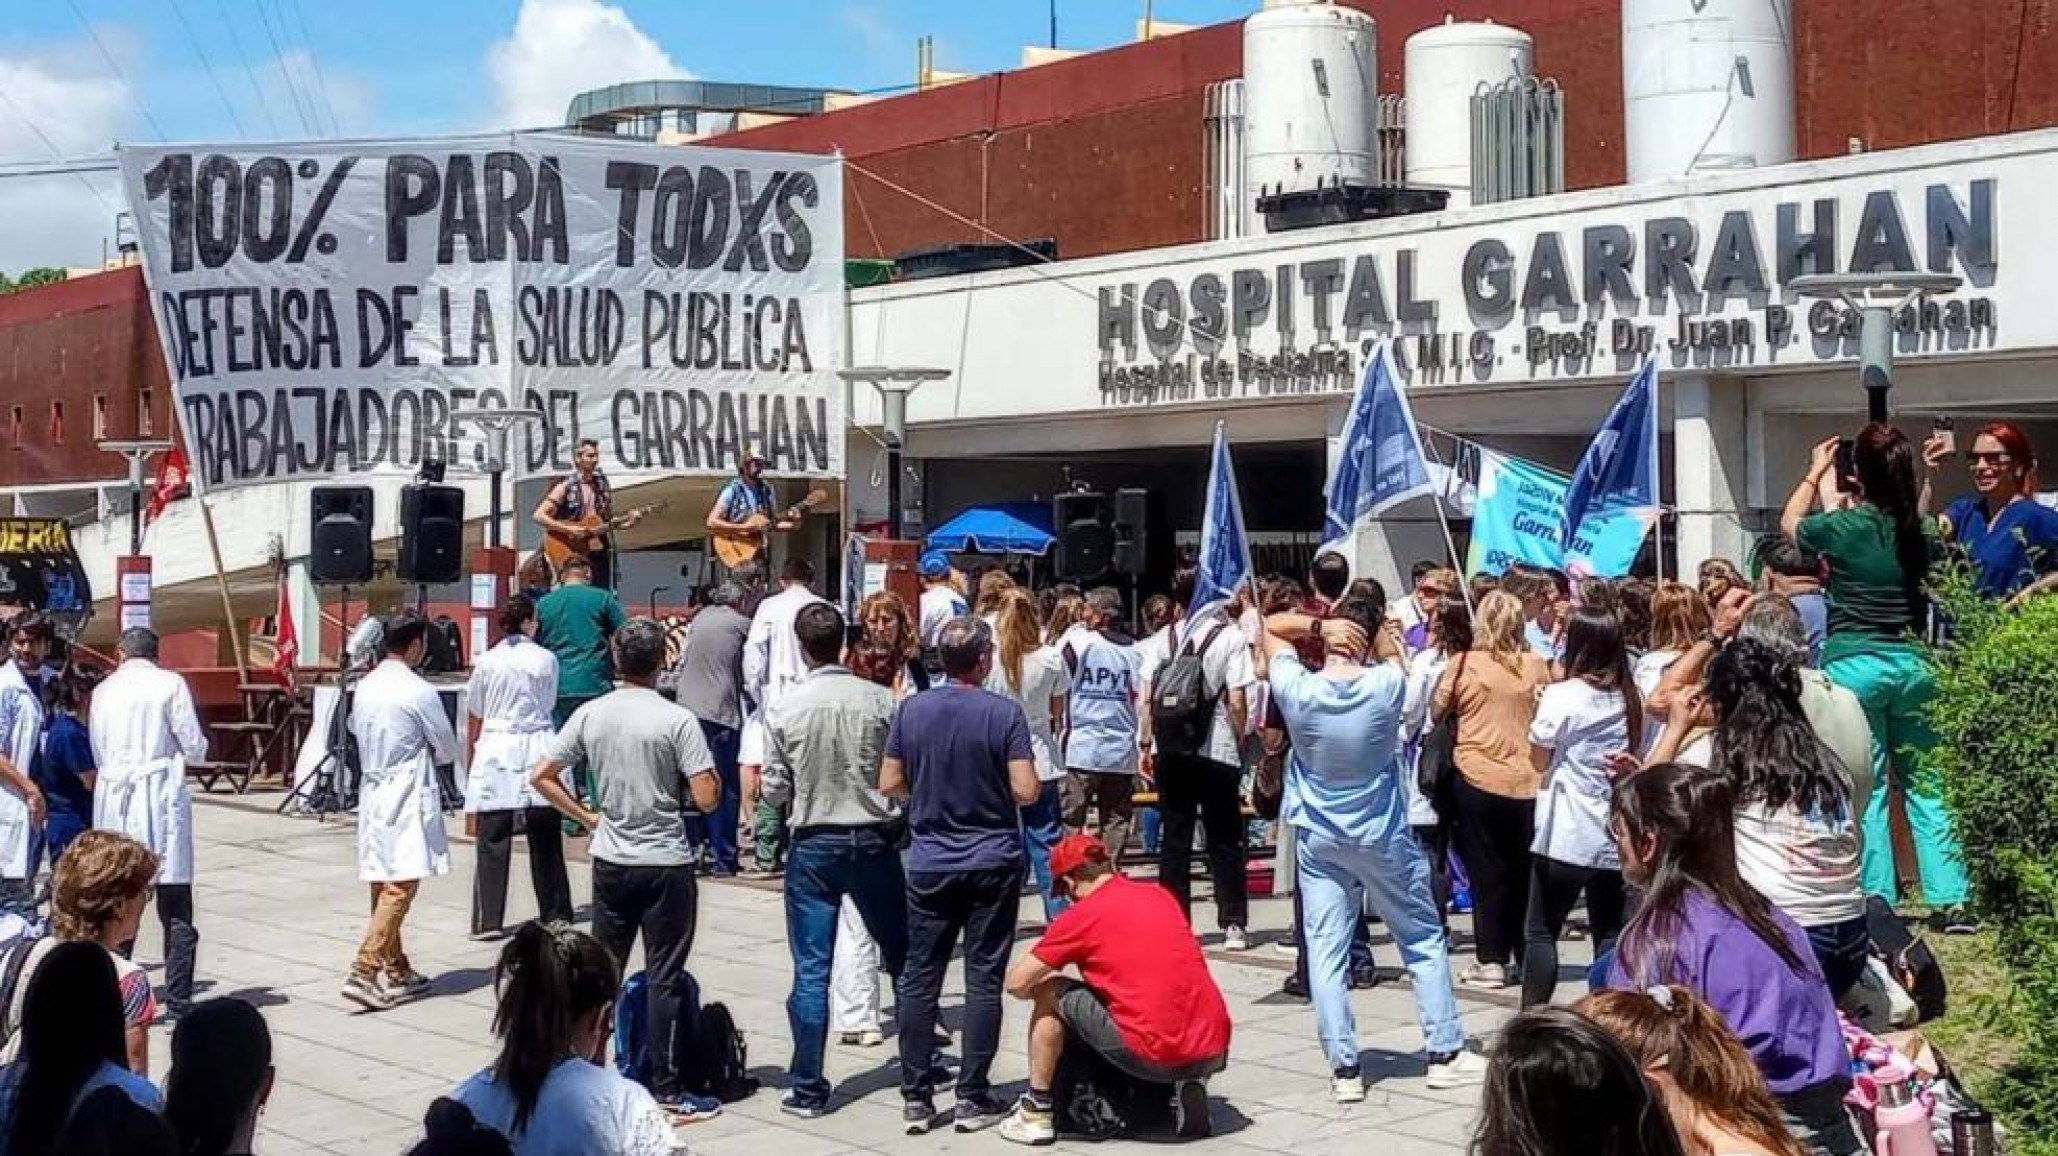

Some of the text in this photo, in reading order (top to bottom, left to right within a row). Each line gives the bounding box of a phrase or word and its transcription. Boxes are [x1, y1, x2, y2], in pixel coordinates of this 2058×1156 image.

[143, 151, 819, 273] 100% PARA TODXS
[1098, 177, 1999, 354] HOSPITAL GARRAHAN
[162, 286, 342, 380] DEFENSA
[356, 286, 420, 368] DE
[440, 286, 498, 366] LA
[516, 285, 625, 368] SALUD
[1100, 352, 1195, 399] Hospital
[1201, 353, 1234, 386] de
[1525, 321, 1605, 366] Prof.
[1611, 317, 1661, 354] Dr.
[1668, 313, 1752, 349] Juan
[1765, 304, 1799, 344] P.
[1808, 295, 1995, 339] Gaahan
[610, 387, 829, 472] GARRAHAN
[1080, 667, 1131, 690] APyT
